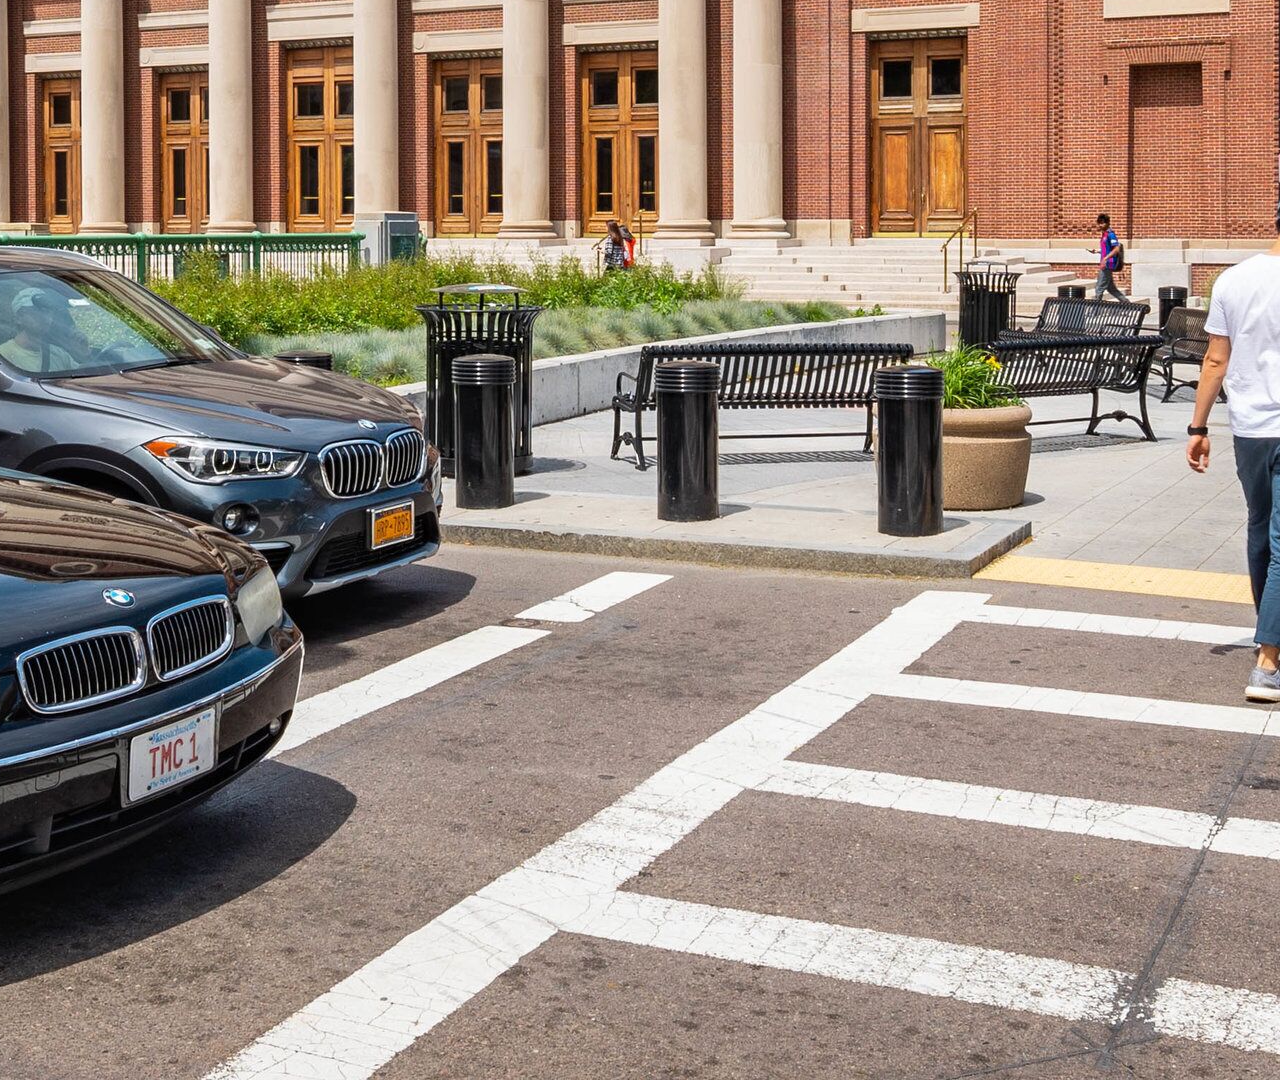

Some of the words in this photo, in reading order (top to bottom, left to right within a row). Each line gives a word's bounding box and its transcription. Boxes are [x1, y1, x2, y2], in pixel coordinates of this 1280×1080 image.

[151, 720, 198, 744] Massachusetts
[148, 738, 184, 779] TMC
[188, 732, 199, 764] 1
